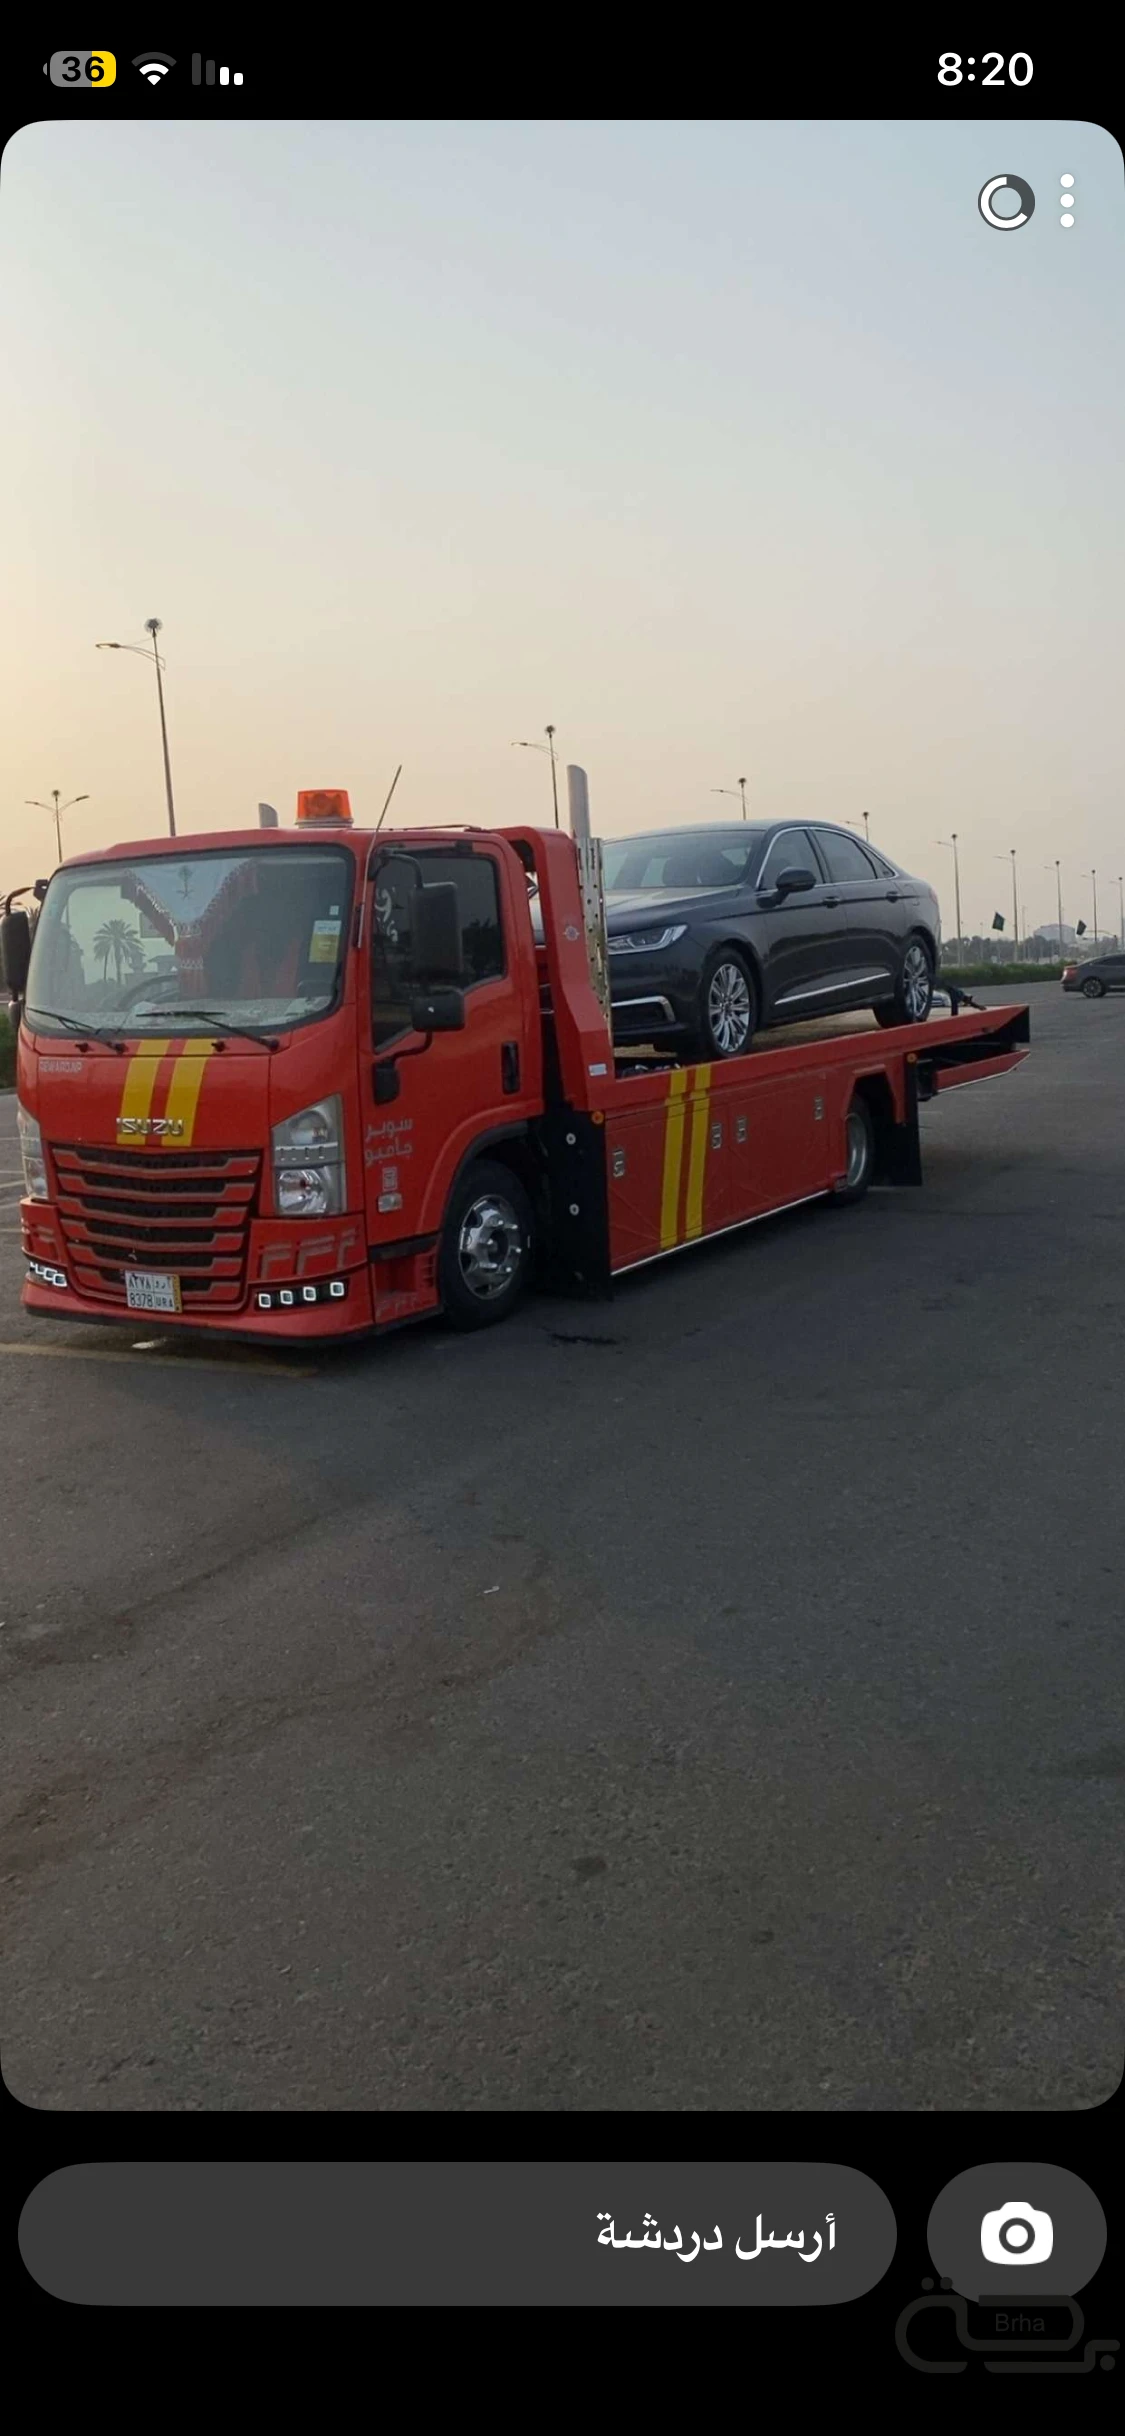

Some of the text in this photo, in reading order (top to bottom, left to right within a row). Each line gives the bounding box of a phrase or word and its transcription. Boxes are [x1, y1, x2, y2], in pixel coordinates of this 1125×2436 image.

[116, 1118, 184, 1136] ISUZU
[365, 1118, 414, 1143] سوبر
[130, 1292, 153, 1307] 8378
